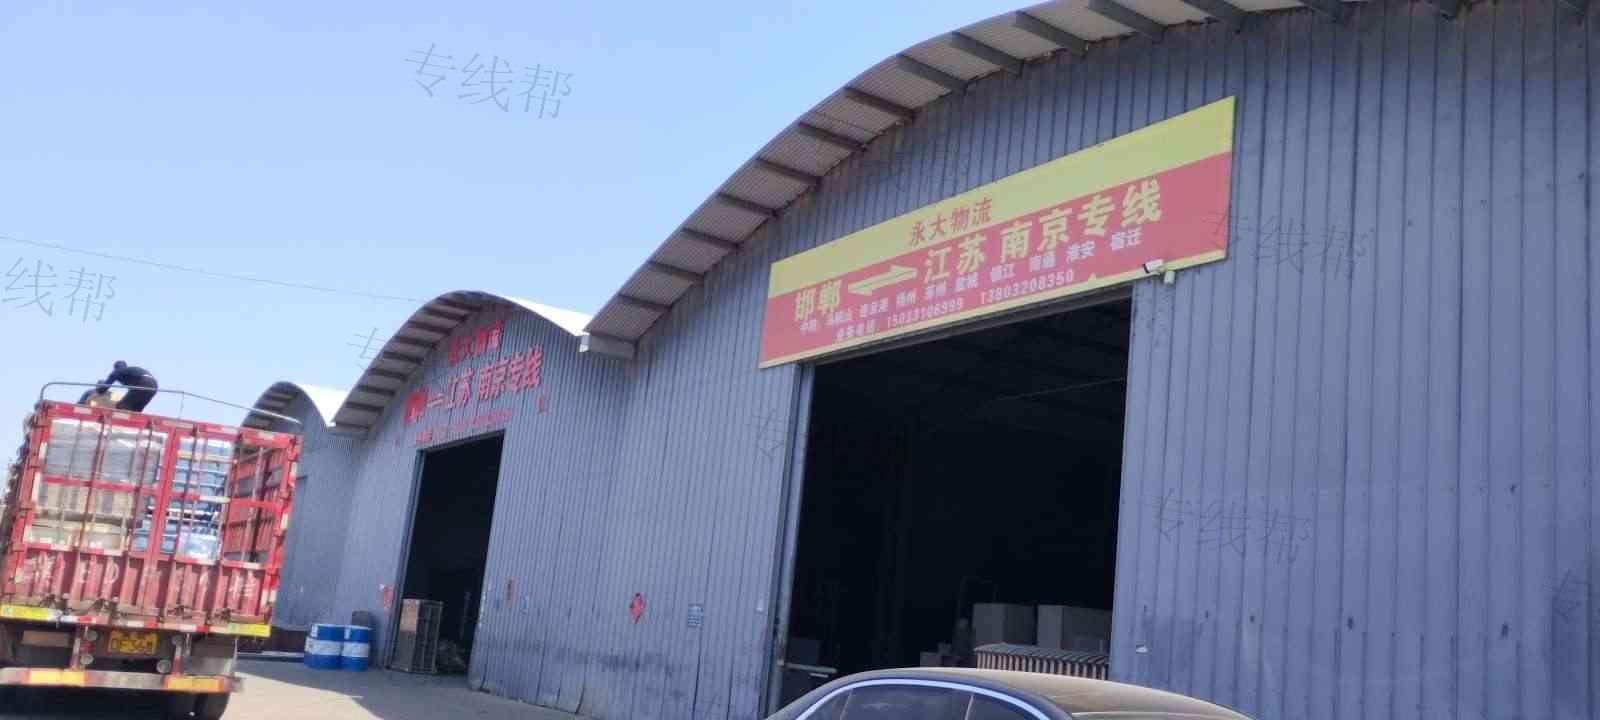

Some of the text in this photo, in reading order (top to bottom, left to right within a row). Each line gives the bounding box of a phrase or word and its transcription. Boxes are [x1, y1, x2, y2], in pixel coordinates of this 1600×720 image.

[794, 178, 1164, 322] 邯郸 江苏 南京专线
[911, 196, 994, 248] 永大物流
